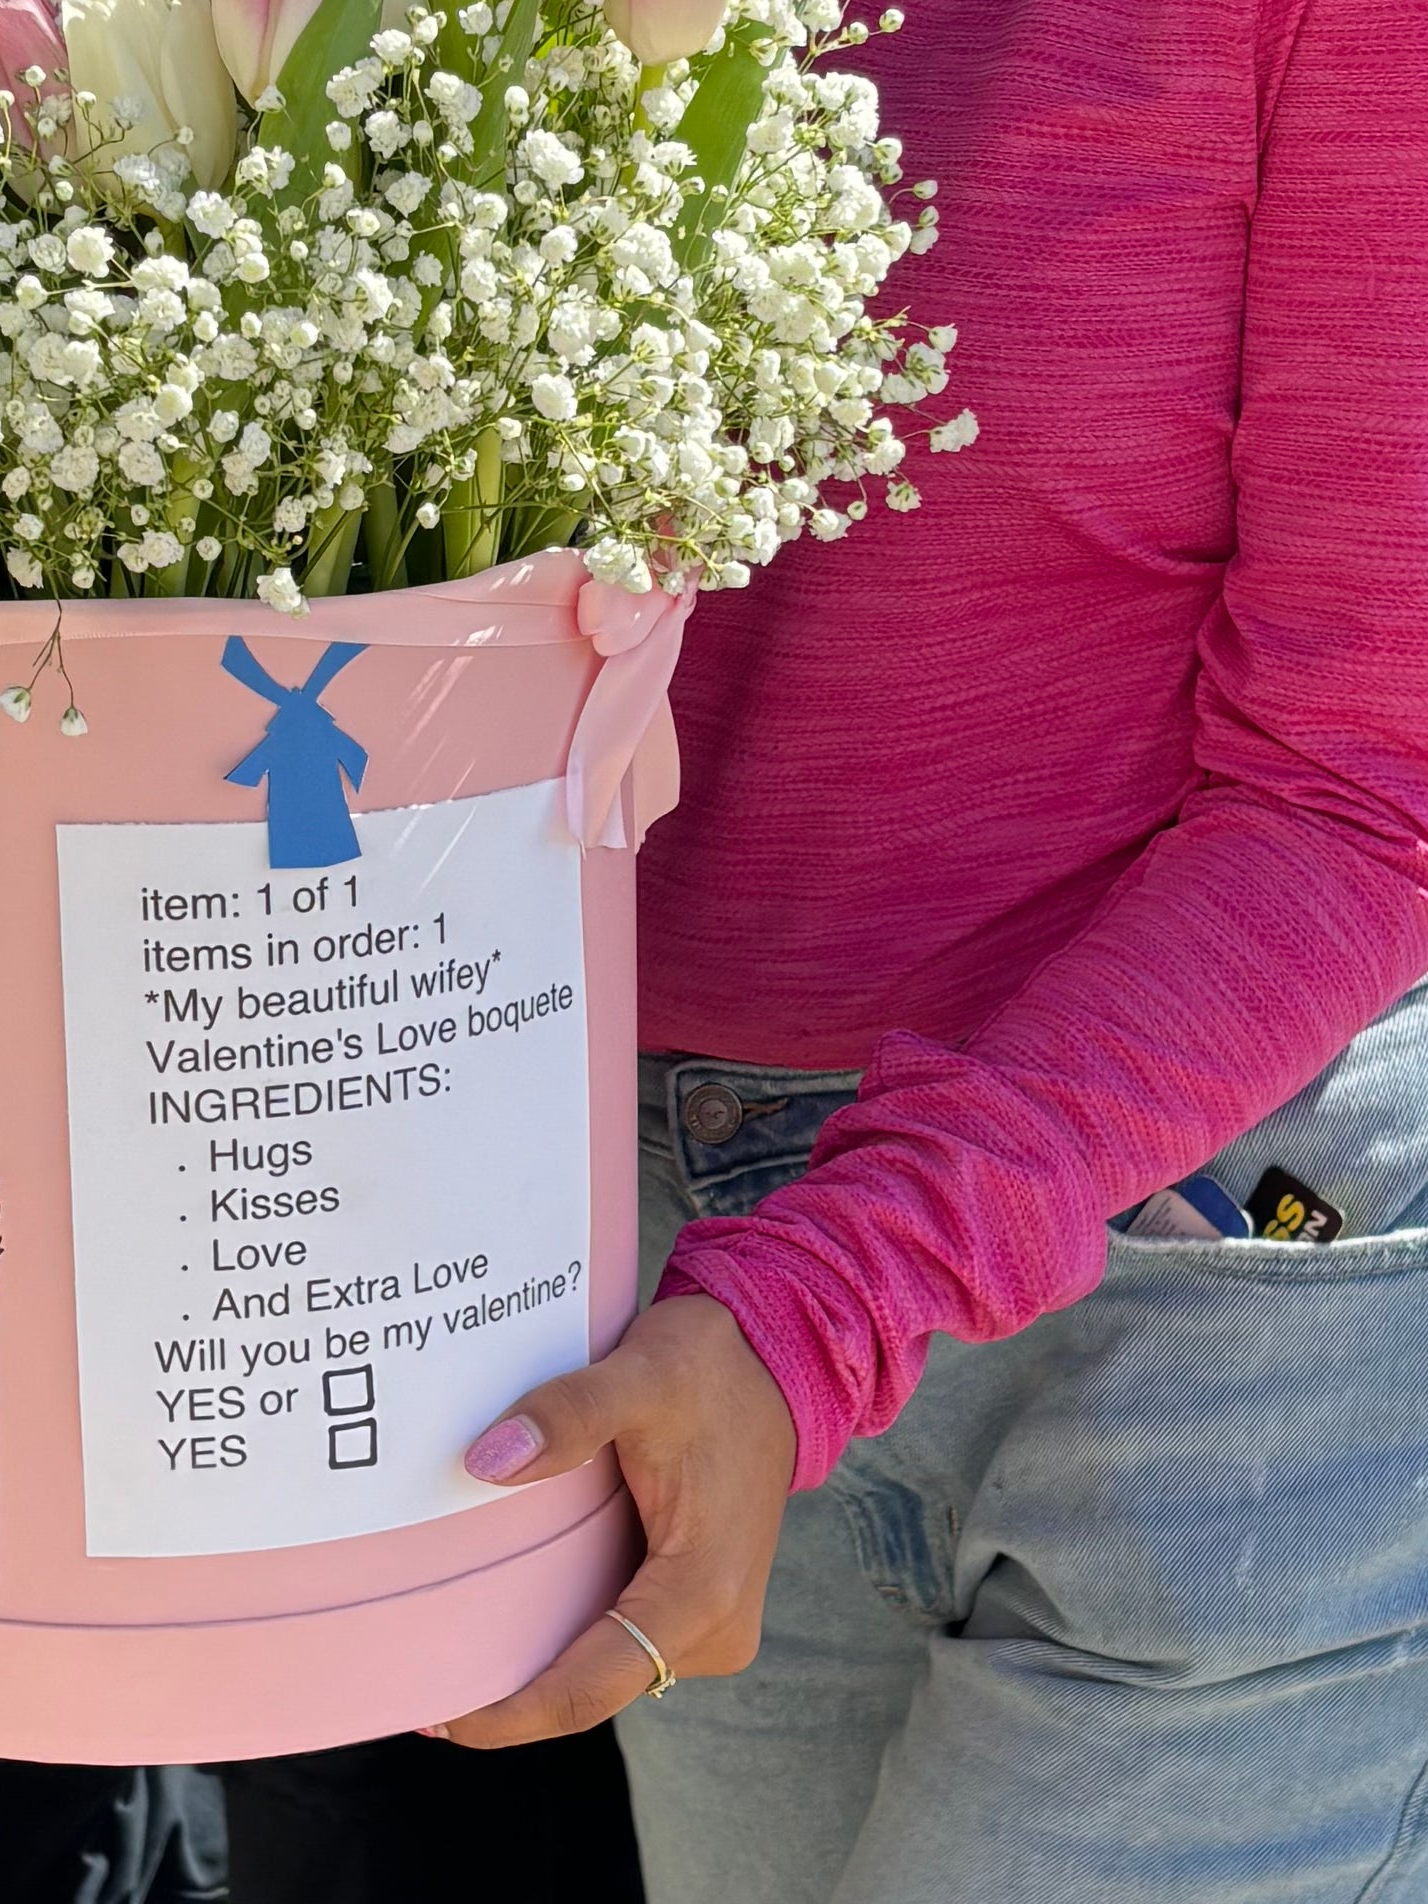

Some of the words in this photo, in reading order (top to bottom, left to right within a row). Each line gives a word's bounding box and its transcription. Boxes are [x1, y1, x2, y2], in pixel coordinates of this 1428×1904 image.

[141, 887, 240, 922] item:
[256, 882, 272, 916] 1
[292, 876, 330, 914] of
[343, 874, 357, 908] 1
[143, 938, 253, 973] items
[266, 932, 299, 967] in
[313, 922, 420, 963] order:
[432, 911, 446, 945] 1
[237, 968, 399, 1020] beautiful
[145, 1027, 364, 1074] Valentine's
[377, 1017, 457, 1056] Love
[468, 982, 573, 1038] boquete
[149, 1062, 451, 1125] INGREDIENTS:
[209, 1137, 313, 1178] Hugs
[211, 1186, 340, 1223] Kisses
[212, 1238, 307, 1272] Love
[211, 1282, 290, 1322] And
[306, 1275, 402, 1313] Extra
[413, 1253, 489, 1295] Love
[153, 1337, 226, 1374] Will
[240, 1337, 311, 1378] you
[325, 1326, 371, 1360] be
[383, 1315, 433, 1352] my
[443, 1260, 582, 1335] valentine?
[155, 1385, 246, 1423] YES
[259, 1387, 300, 1416] or
[157, 1434, 248, 1471] YES
